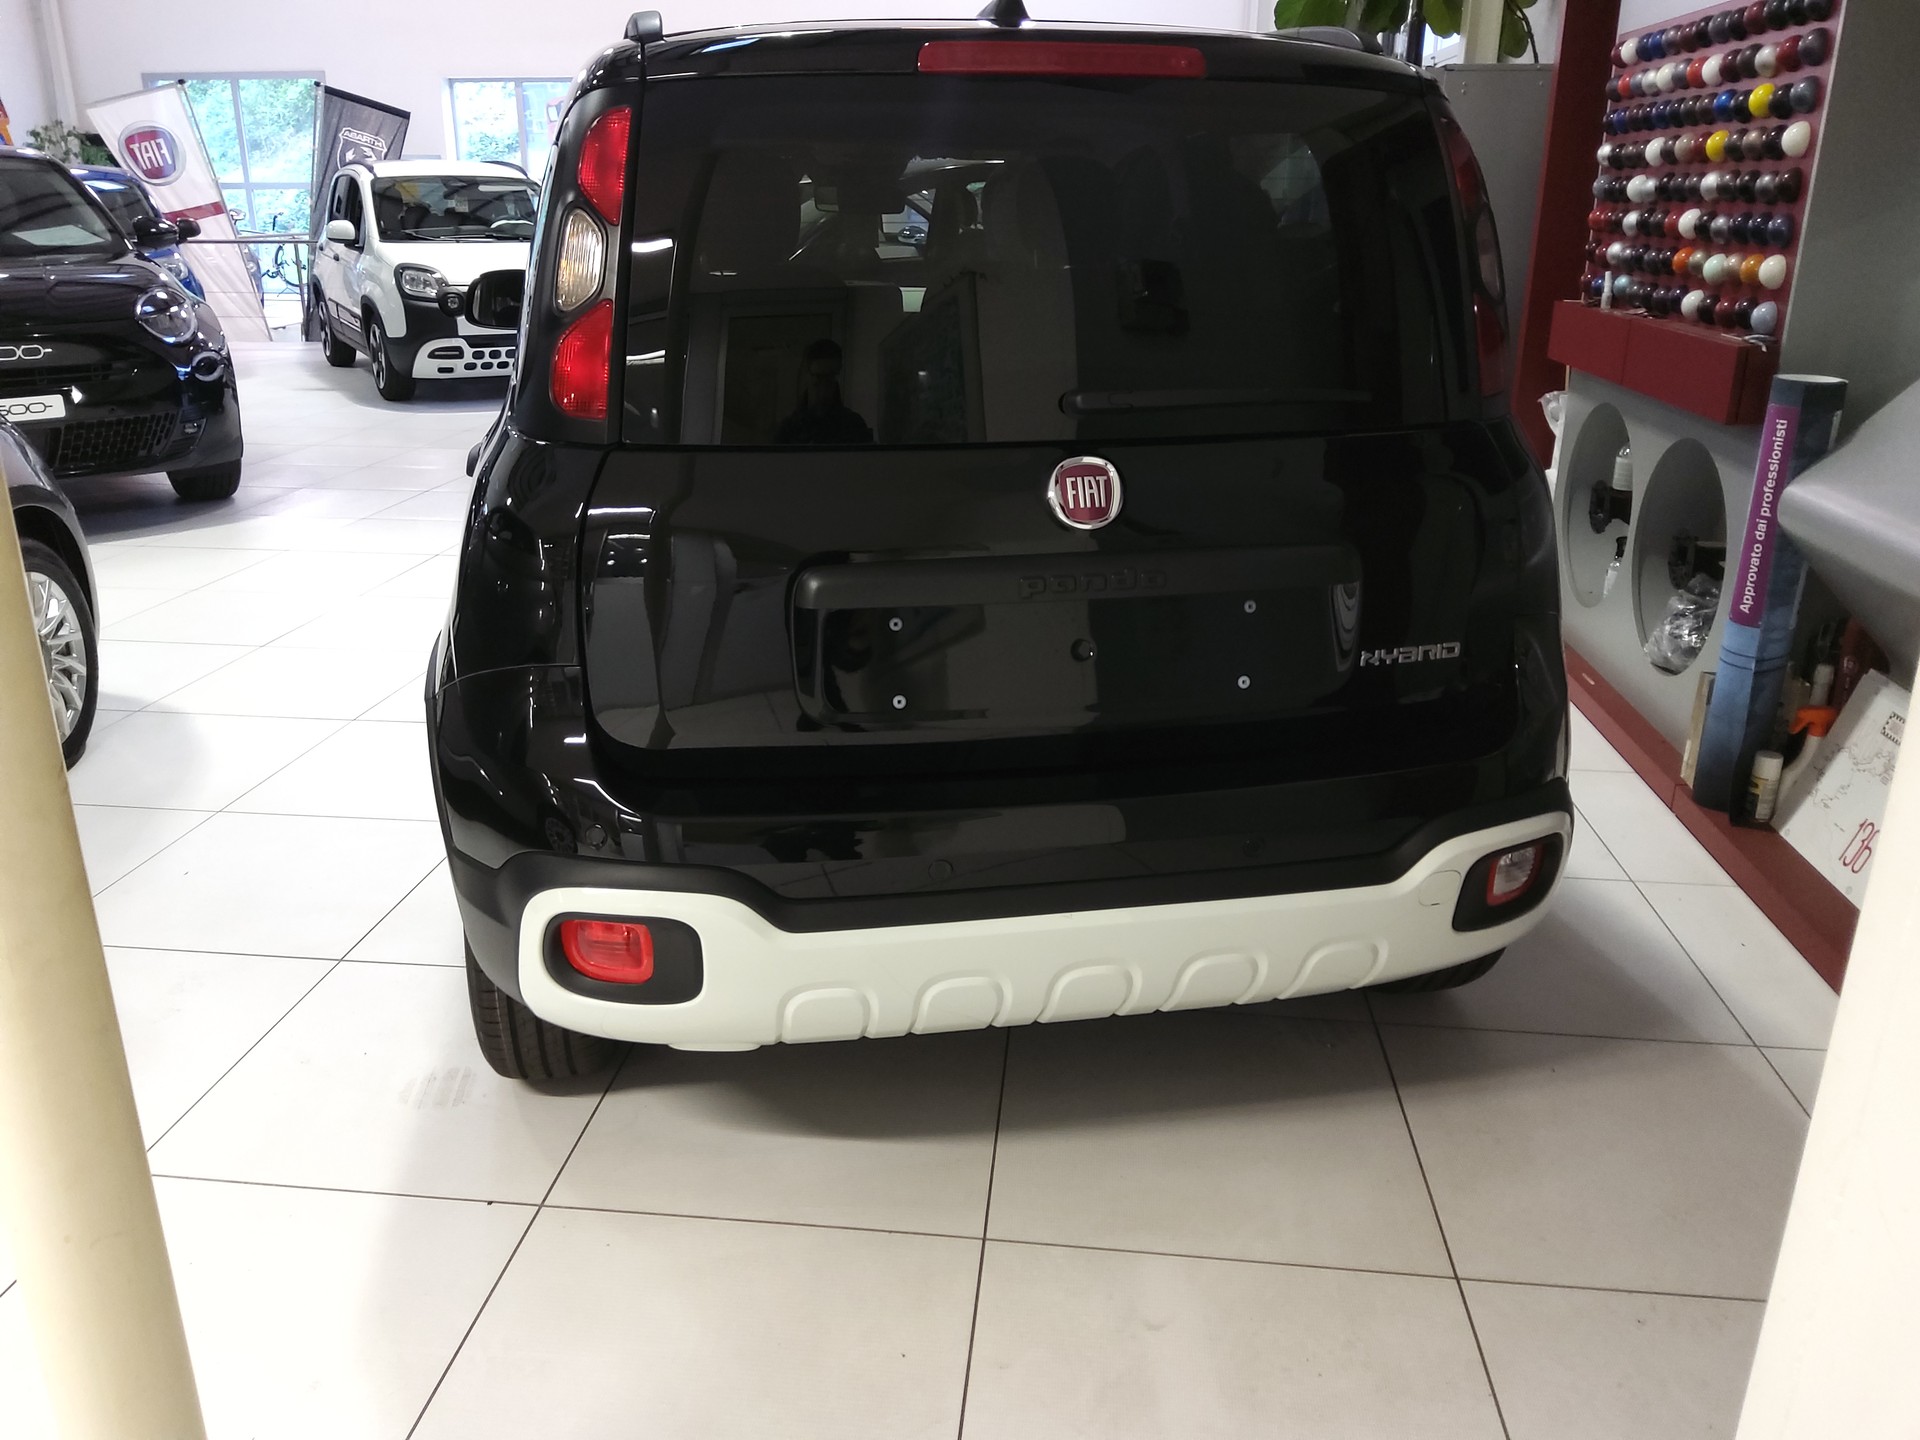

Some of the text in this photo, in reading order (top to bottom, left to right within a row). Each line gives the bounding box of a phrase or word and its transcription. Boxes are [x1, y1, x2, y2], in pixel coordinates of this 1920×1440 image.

[343, 130, 383, 148] ABARTH
[1065, 475, 1108, 510] FIAT
[1739, 418, 1788, 615] Approvato dai professionisti
[1018, 565, 1169, 600] panda
[1359, 641, 1461, 667] HYBRID
[1838, 817, 1881, 874] 136
